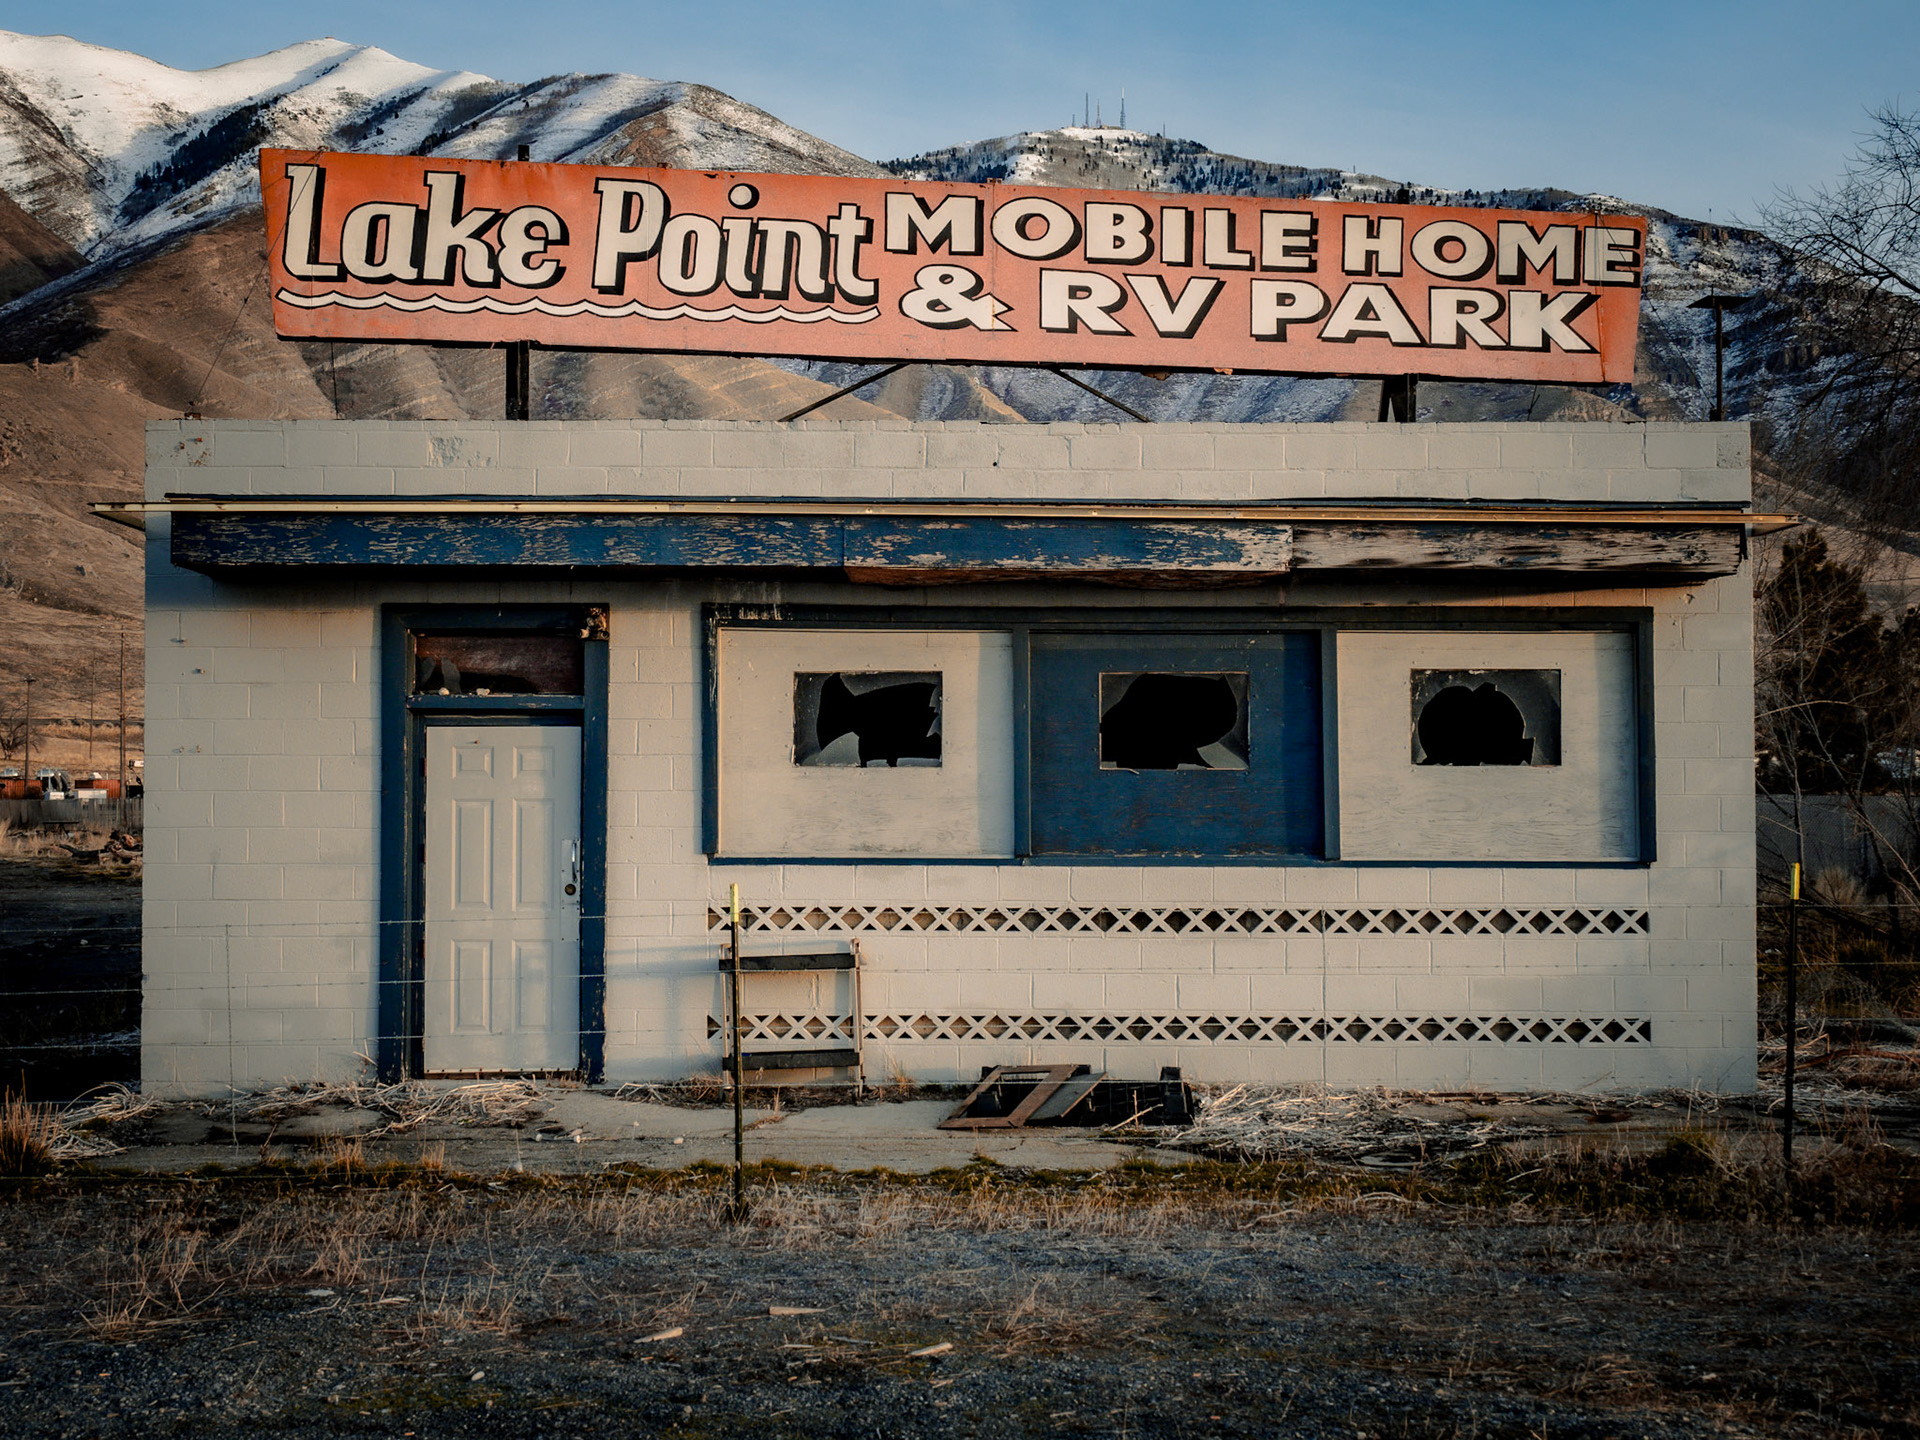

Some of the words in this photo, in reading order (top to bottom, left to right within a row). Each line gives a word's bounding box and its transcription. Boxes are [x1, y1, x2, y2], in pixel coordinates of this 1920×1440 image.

[284, 163, 569, 287] Lake
[593, 177, 879, 303] Point
[885, 192, 1319, 273] MOBILE
[1342, 214, 1641, 287] HOME
[900, 264, 1016, 332] &
[1039, 268, 1226, 339] RV
[1249, 278, 1601, 353] PARK
